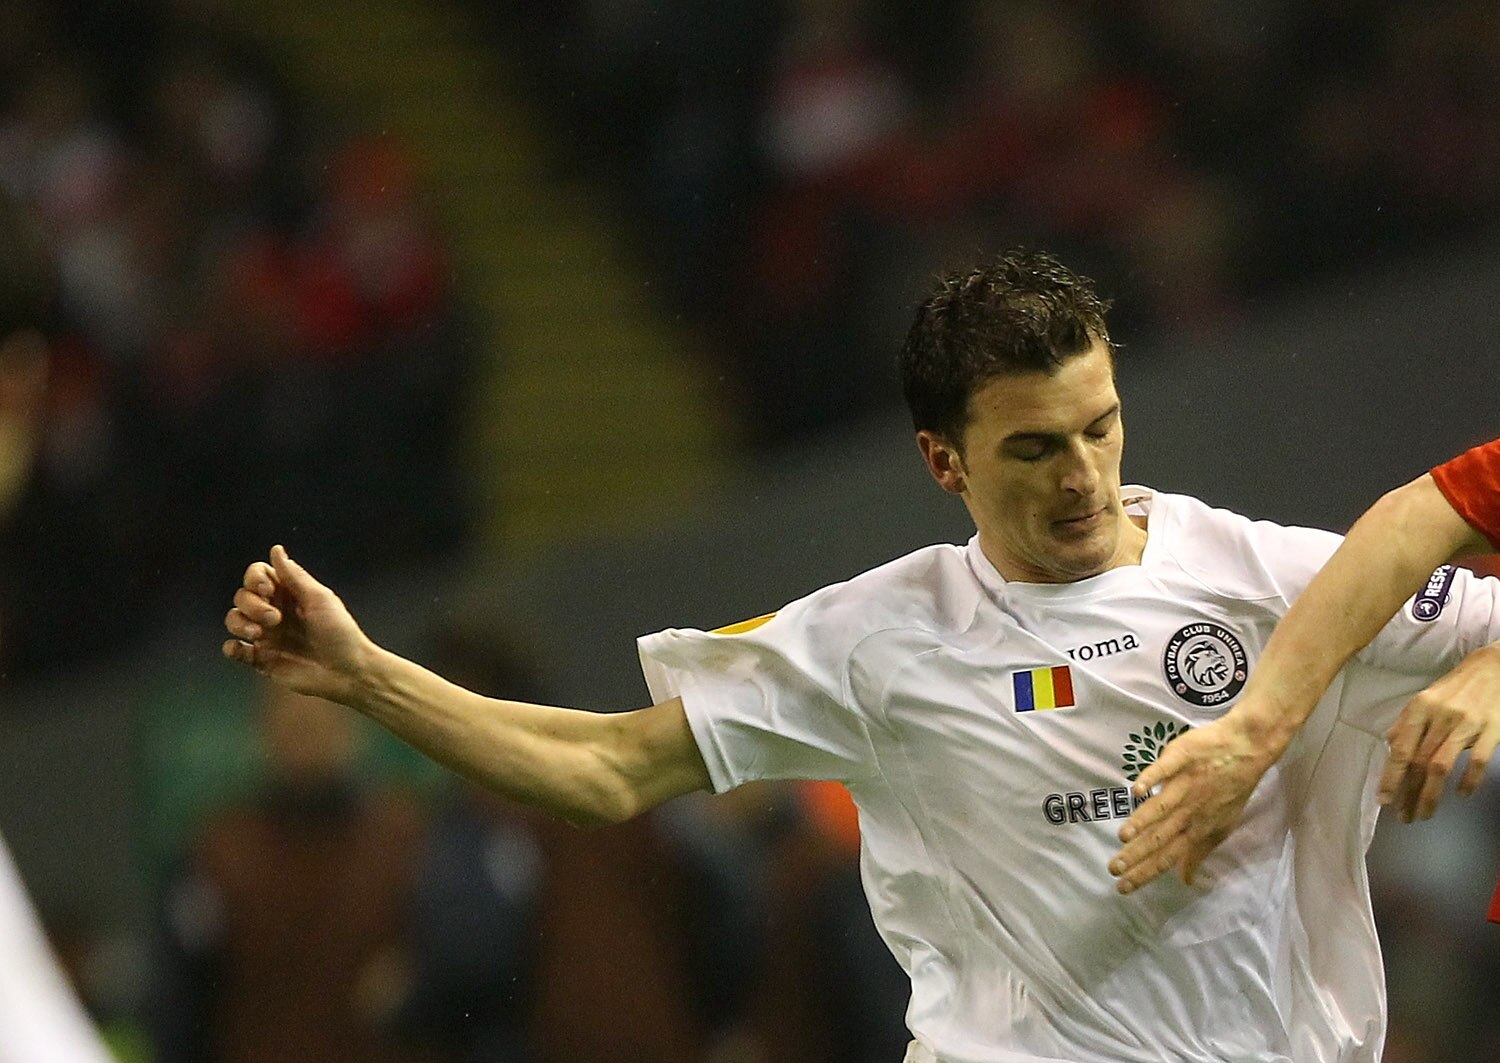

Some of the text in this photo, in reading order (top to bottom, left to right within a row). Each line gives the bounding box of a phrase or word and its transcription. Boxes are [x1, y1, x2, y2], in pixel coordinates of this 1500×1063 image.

[1424, 564, 1451, 597] RESP
[1167, 625, 1245, 680] FOTBAL CLUB UNIREA
[1201, 690, 1230, 703] 1954
